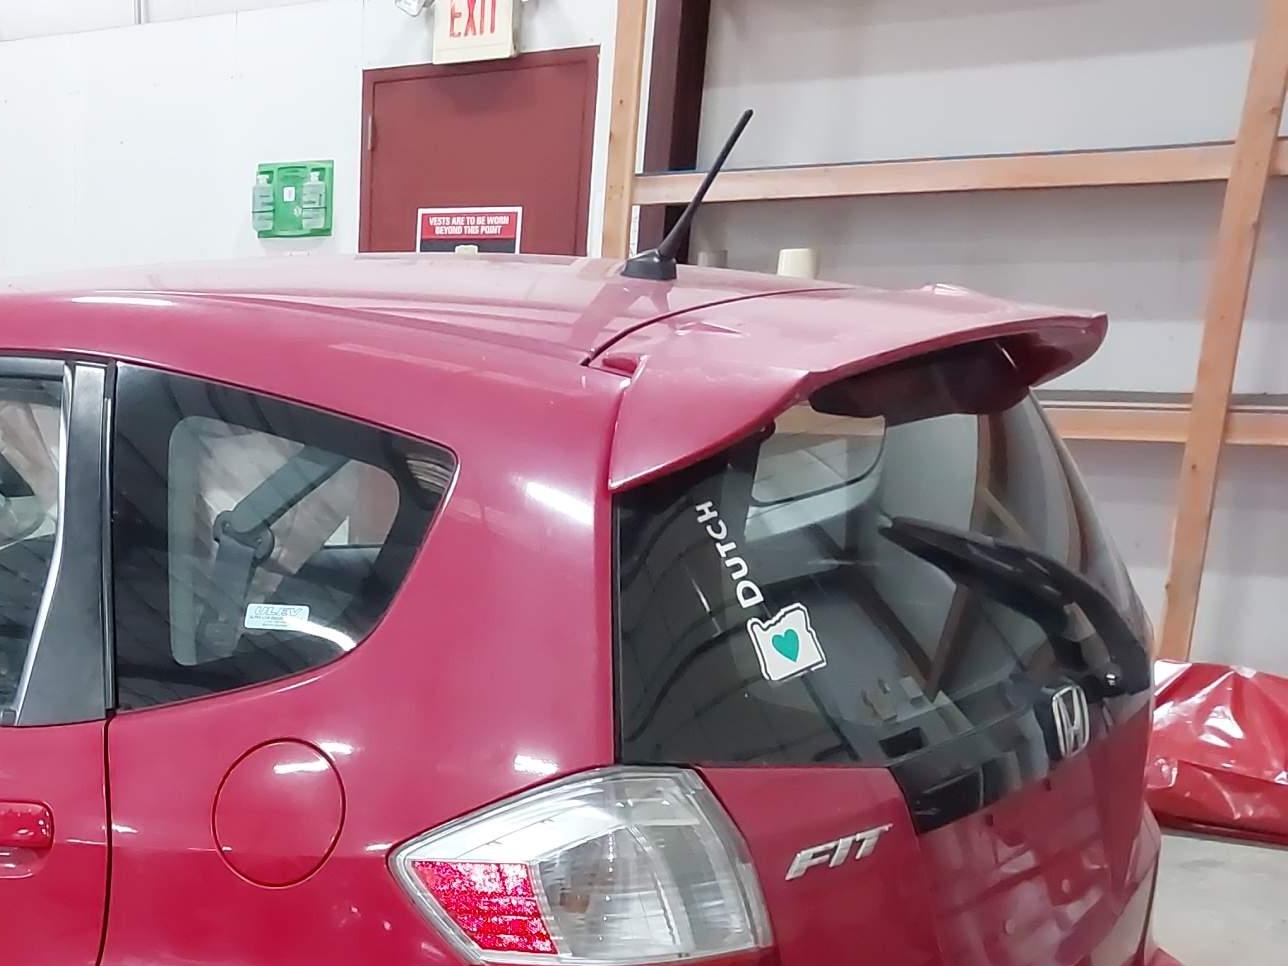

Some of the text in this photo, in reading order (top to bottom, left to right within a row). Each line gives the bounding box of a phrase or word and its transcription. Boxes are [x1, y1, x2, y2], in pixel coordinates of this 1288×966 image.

[429, 215, 510, 226] VESTS ARE TO BE WORN
[435, 225, 503, 235] BEYOND THIS POINT
[695, 501, 765, 609] DUTCH
[784, 823, 894, 881] FIT
